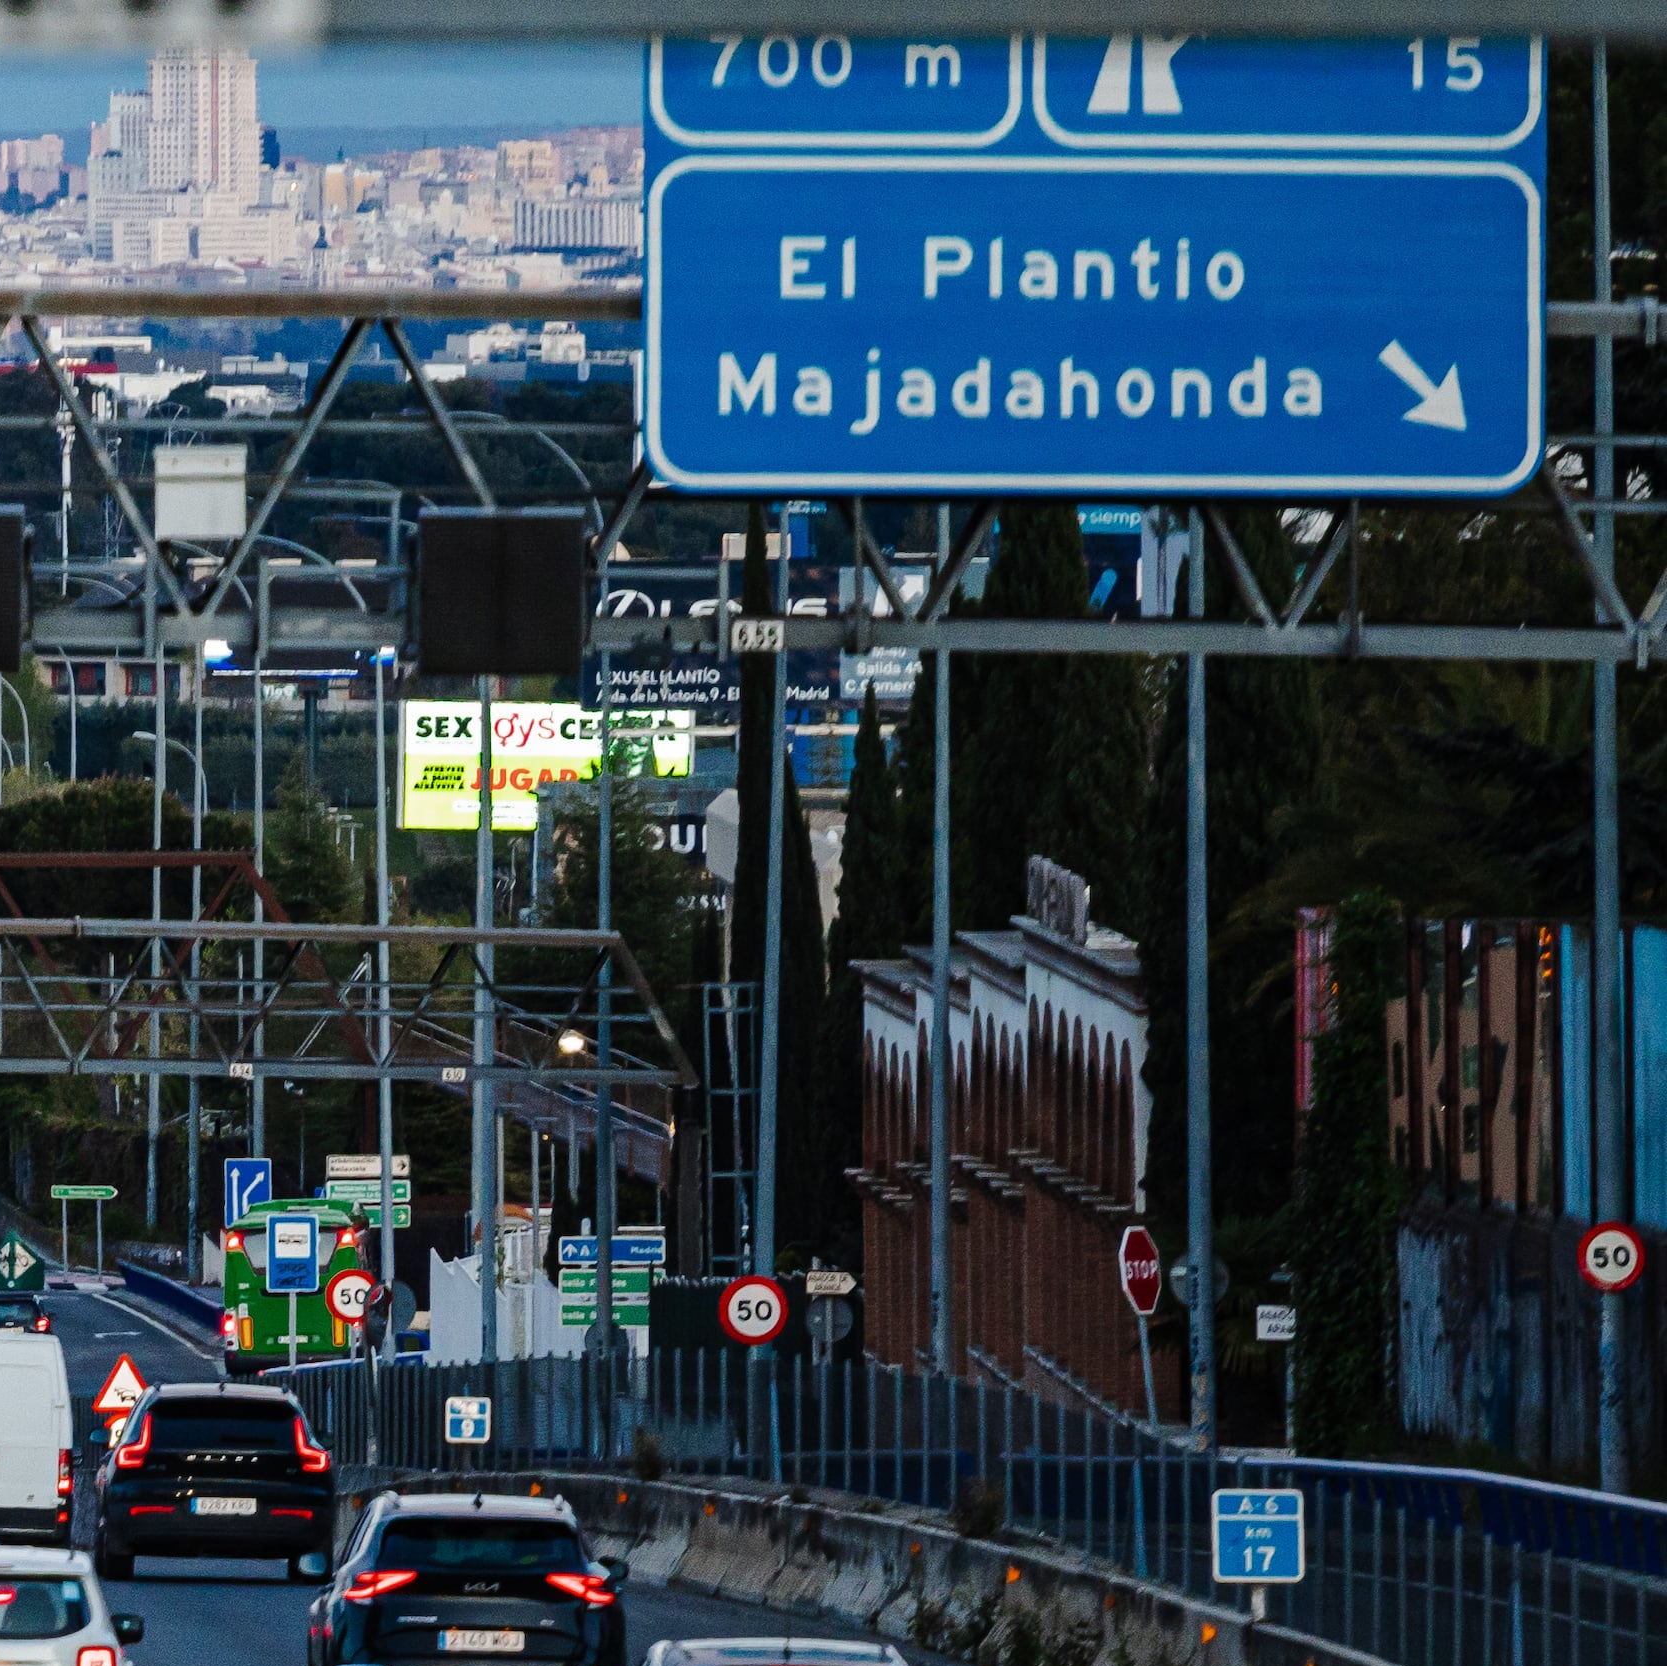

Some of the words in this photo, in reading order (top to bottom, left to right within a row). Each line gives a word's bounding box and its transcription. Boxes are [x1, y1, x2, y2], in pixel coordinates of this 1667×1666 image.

[709, 32, 854, 89] 700
[904, 43, 961, 88] m
[1406, 36, 1485, 91] 15
[780, 236, 857, 300] El
[718, 347, 1323, 437] Majadahonda
[596, 670, 639, 685] LXUS
[786, 685, 830, 701] Madrid
[416, 716, 474, 739] SEX
[1592, 1244, 1630, 1269] 50
[1124, 1259, 1158, 1281] STOP
[340, 1288, 367, 1305] 50
[736, 1299, 773, 1323] 50
[1237, 1496, 1279, 1515] A-6
[1244, 1525, 1273, 1539] km
[1243, 1546, 1276, 1573] 17
